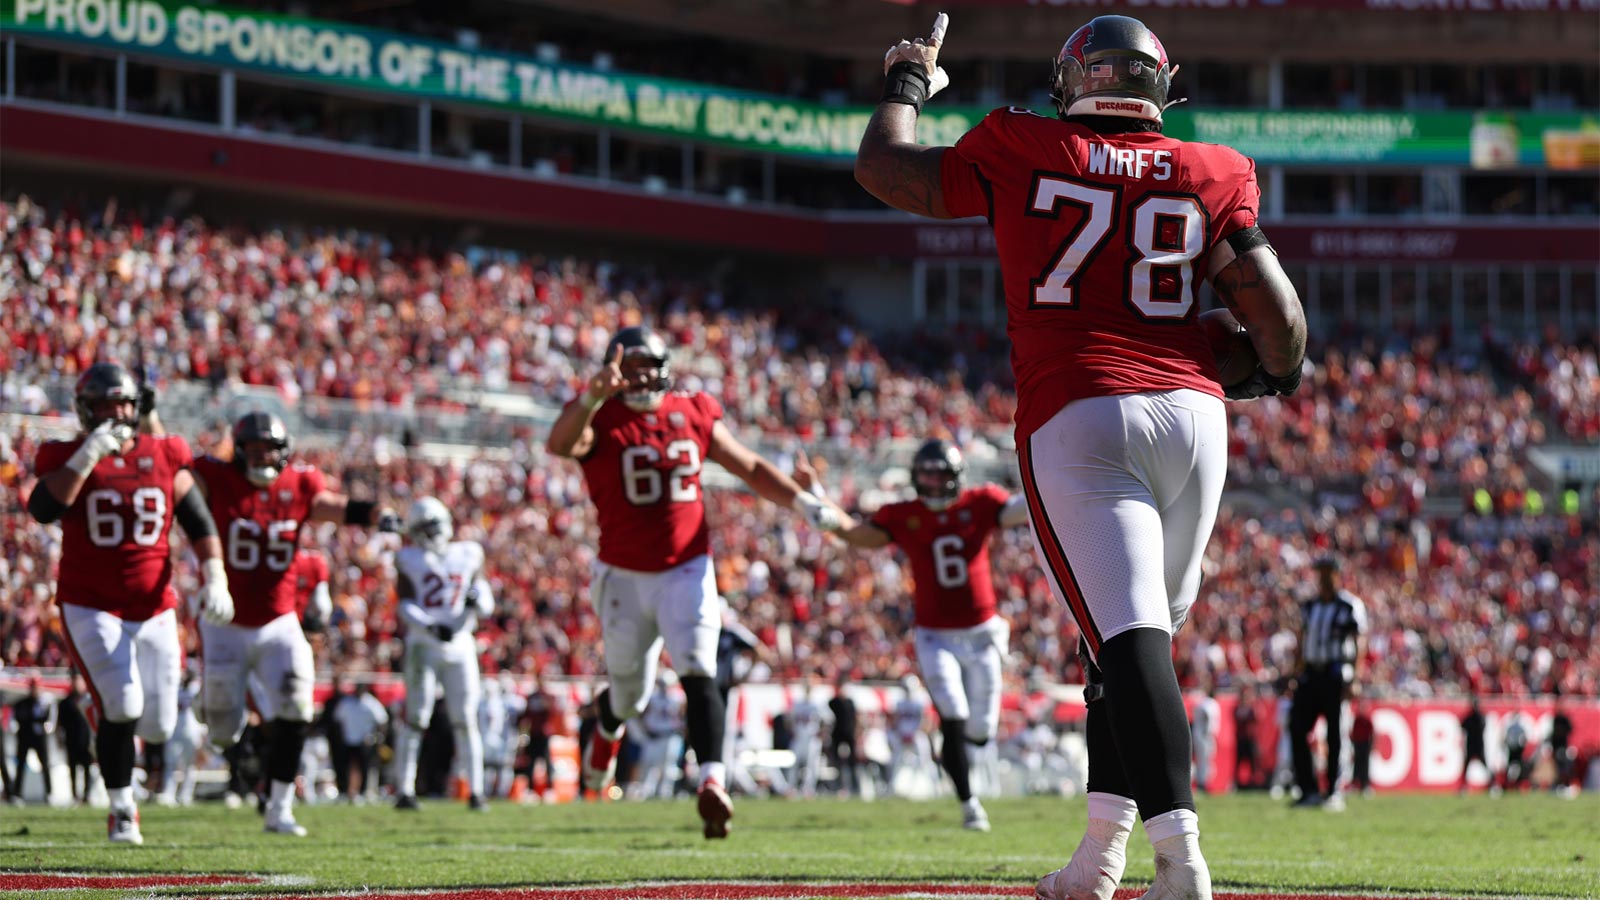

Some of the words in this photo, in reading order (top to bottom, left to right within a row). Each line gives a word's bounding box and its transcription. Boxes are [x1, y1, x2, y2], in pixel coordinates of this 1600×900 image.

[15, 0, 167, 47] PROUD
[175, 7, 372, 80] SPONSOR
[379, 41, 434, 87] OF
[438, 50, 511, 102] THE
[514, 63, 632, 123] TAMPA
[636, 83, 700, 133] BAY
[1089, 143, 1172, 181] WIRFS
[1028, 172, 1209, 322] 78
[623, 439, 702, 506] 62
[86, 486, 167, 547] 68
[227, 518, 299, 572] 65
[932, 534, 969, 589] 6
[422, 573, 466, 609] 27
